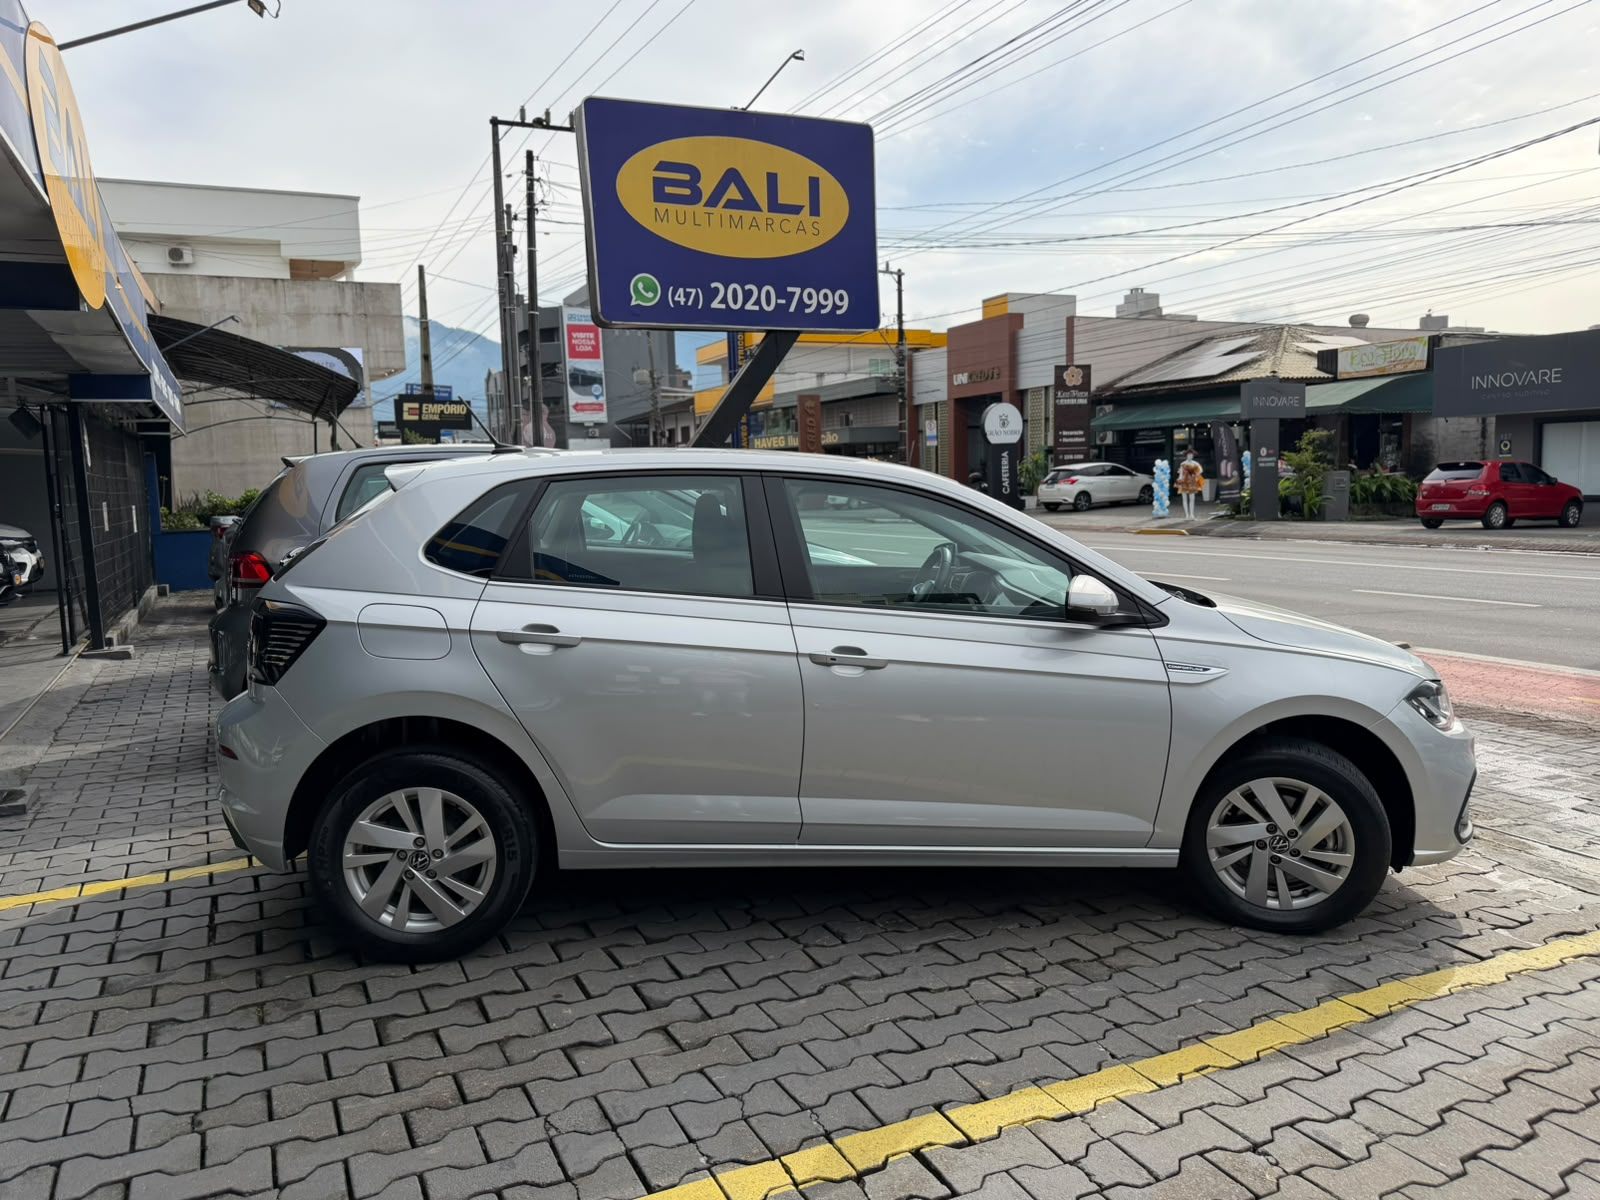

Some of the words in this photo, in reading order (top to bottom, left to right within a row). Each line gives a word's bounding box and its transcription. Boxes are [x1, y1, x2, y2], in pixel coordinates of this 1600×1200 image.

[652, 160, 820, 217] BALI
[654, 207, 820, 236] MULTIMARCAS
[668, 286, 703, 309] (47)
[710, 281, 849, 315] 2020-7999
[1471, 368, 1562, 389] INNOVARE
[422, 401, 467, 415] EMPÓRIO
[1253, 396, 1300, 406] INNOVARE
[754, 436, 785, 448] HAVEG
[1001, 451, 1010, 494] CAFETERIA
